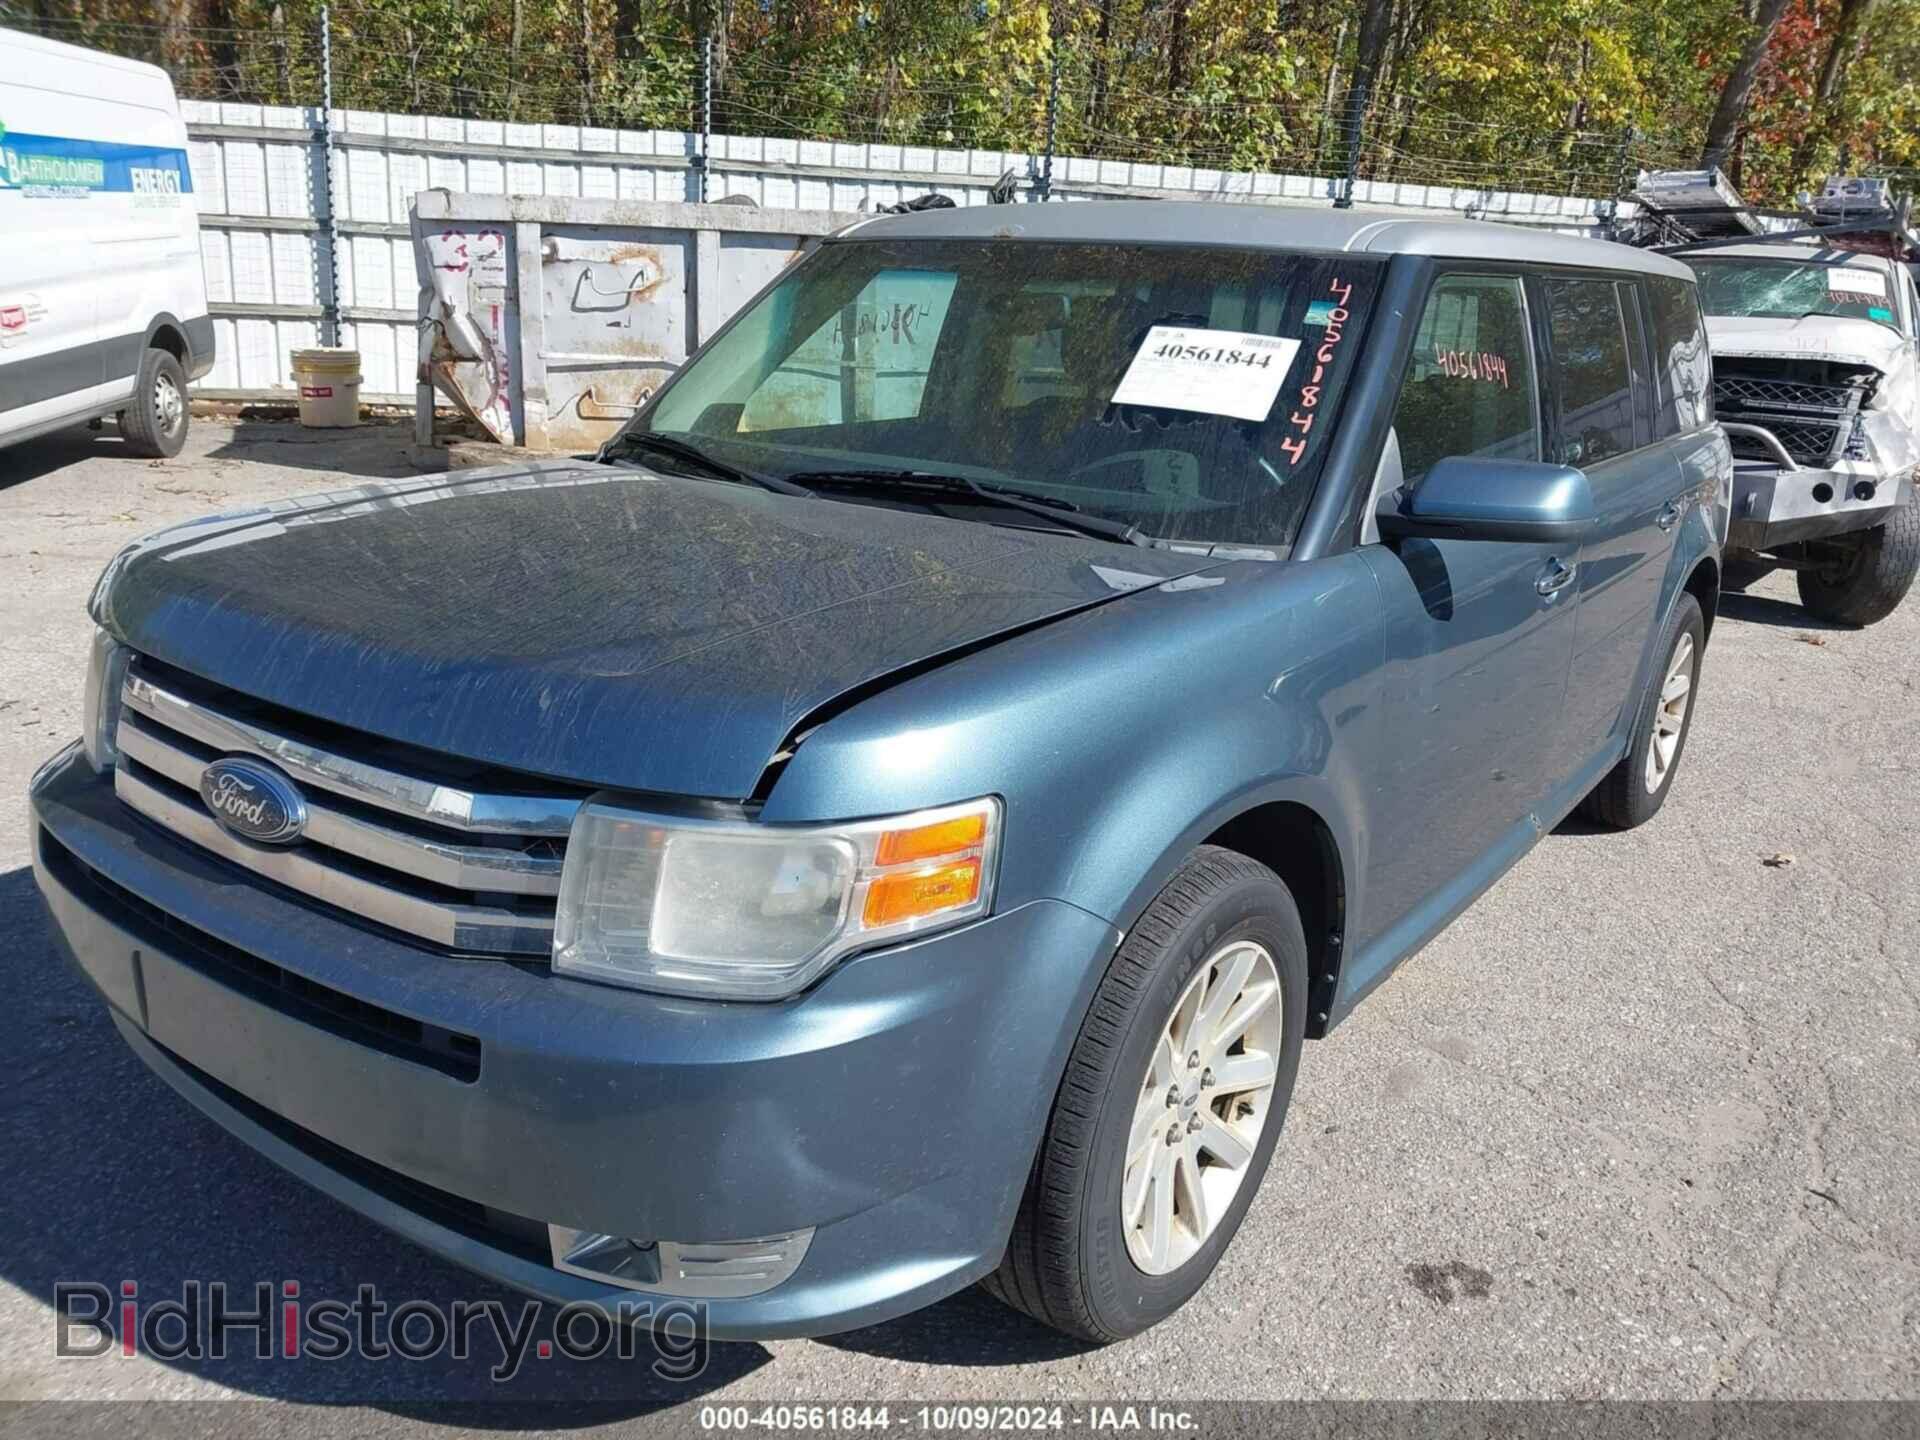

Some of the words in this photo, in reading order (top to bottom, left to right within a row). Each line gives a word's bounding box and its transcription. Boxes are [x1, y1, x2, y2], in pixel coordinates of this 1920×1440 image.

[130, 167, 181, 194] ENERGY
[1153, 343, 1272, 369] 40561844
[1281, 277, 1352, 465] 40561844
[1434, 342, 1509, 390] 40561844
[211, 773, 268, 825] Ford
